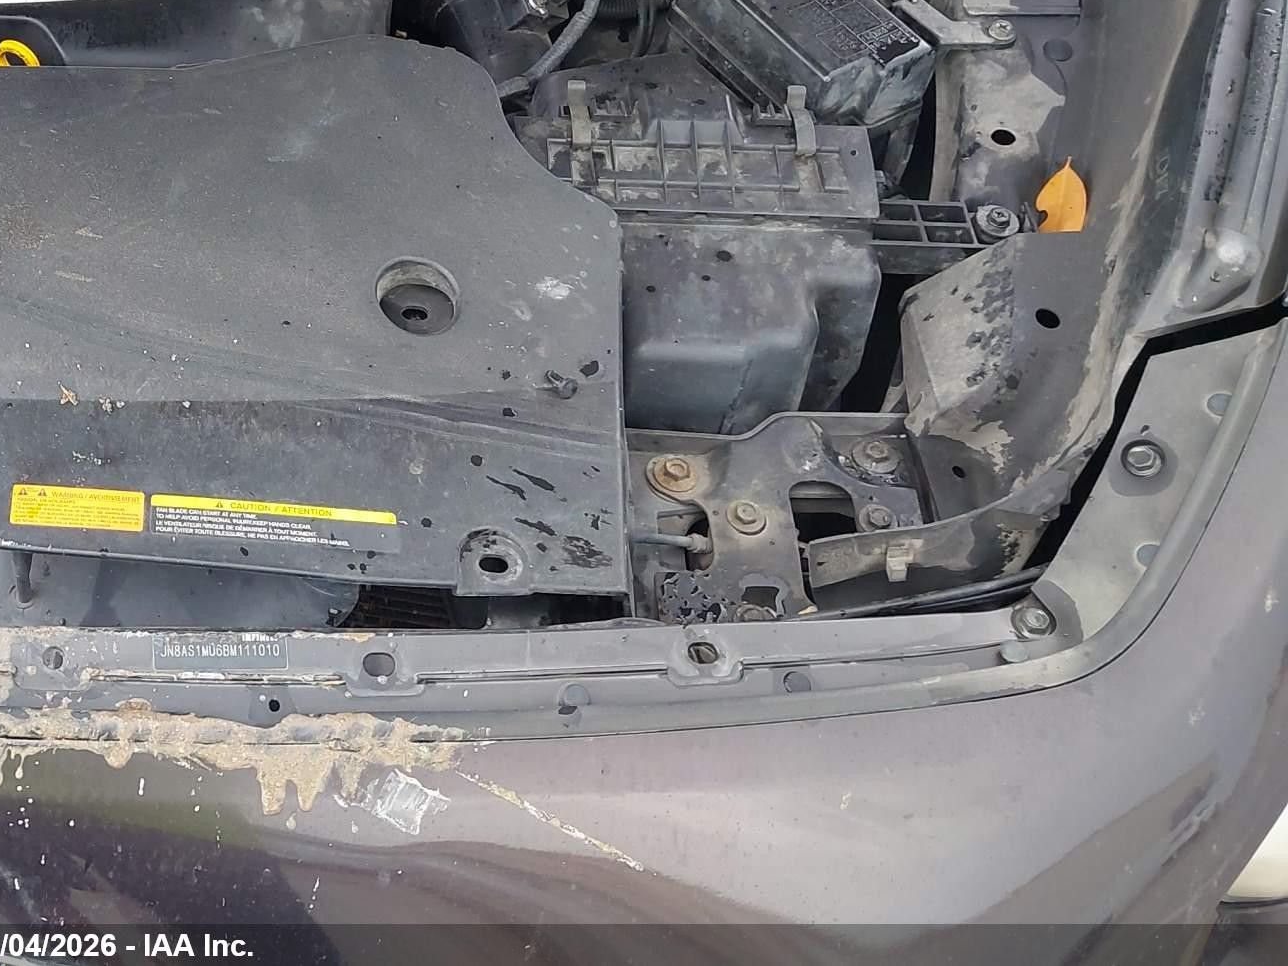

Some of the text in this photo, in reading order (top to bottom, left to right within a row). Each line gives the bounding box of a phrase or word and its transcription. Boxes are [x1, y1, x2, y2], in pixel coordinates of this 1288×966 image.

[230, 502, 271, 512] CAUTION
[281, 506, 332, 517] ATTENTION
[160, 644, 281, 658] JN8AS1MU6BM111010
